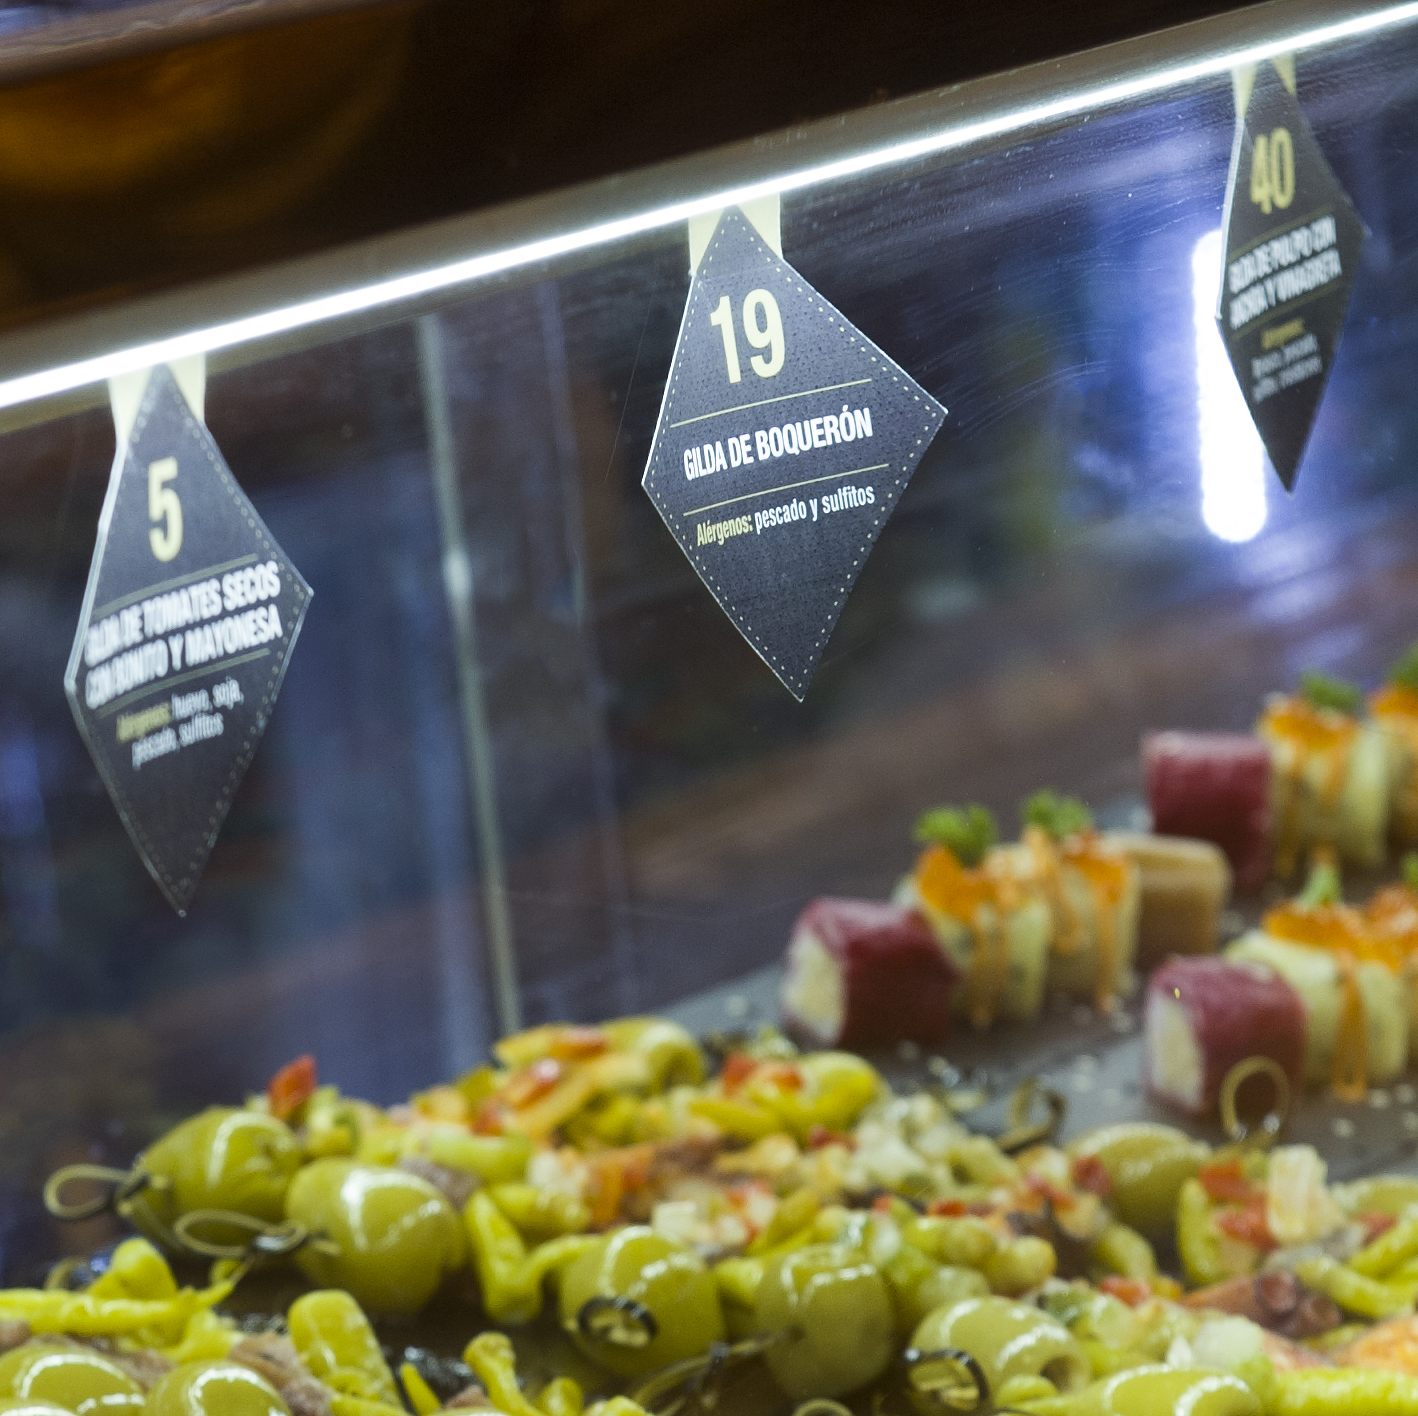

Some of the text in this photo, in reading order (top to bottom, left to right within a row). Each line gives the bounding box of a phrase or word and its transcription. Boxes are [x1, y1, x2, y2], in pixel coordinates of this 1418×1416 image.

[1250, 126, 1295, 214] 40
[709, 287, 786, 385] 19
[683, 404, 873, 480] GILDA DE BOQUERÓN
[147, 456, 183, 563] 5
[696, 485, 875, 546] Alérgenos: pescado y sulfitos
[141, 577, 222, 636] TOMATES
[222, 560, 280, 611] SECOS
[111, 639, 169, 695] BONITO
[168, 633, 184, 671] Y
[185, 603, 283, 667] MAYONESA
